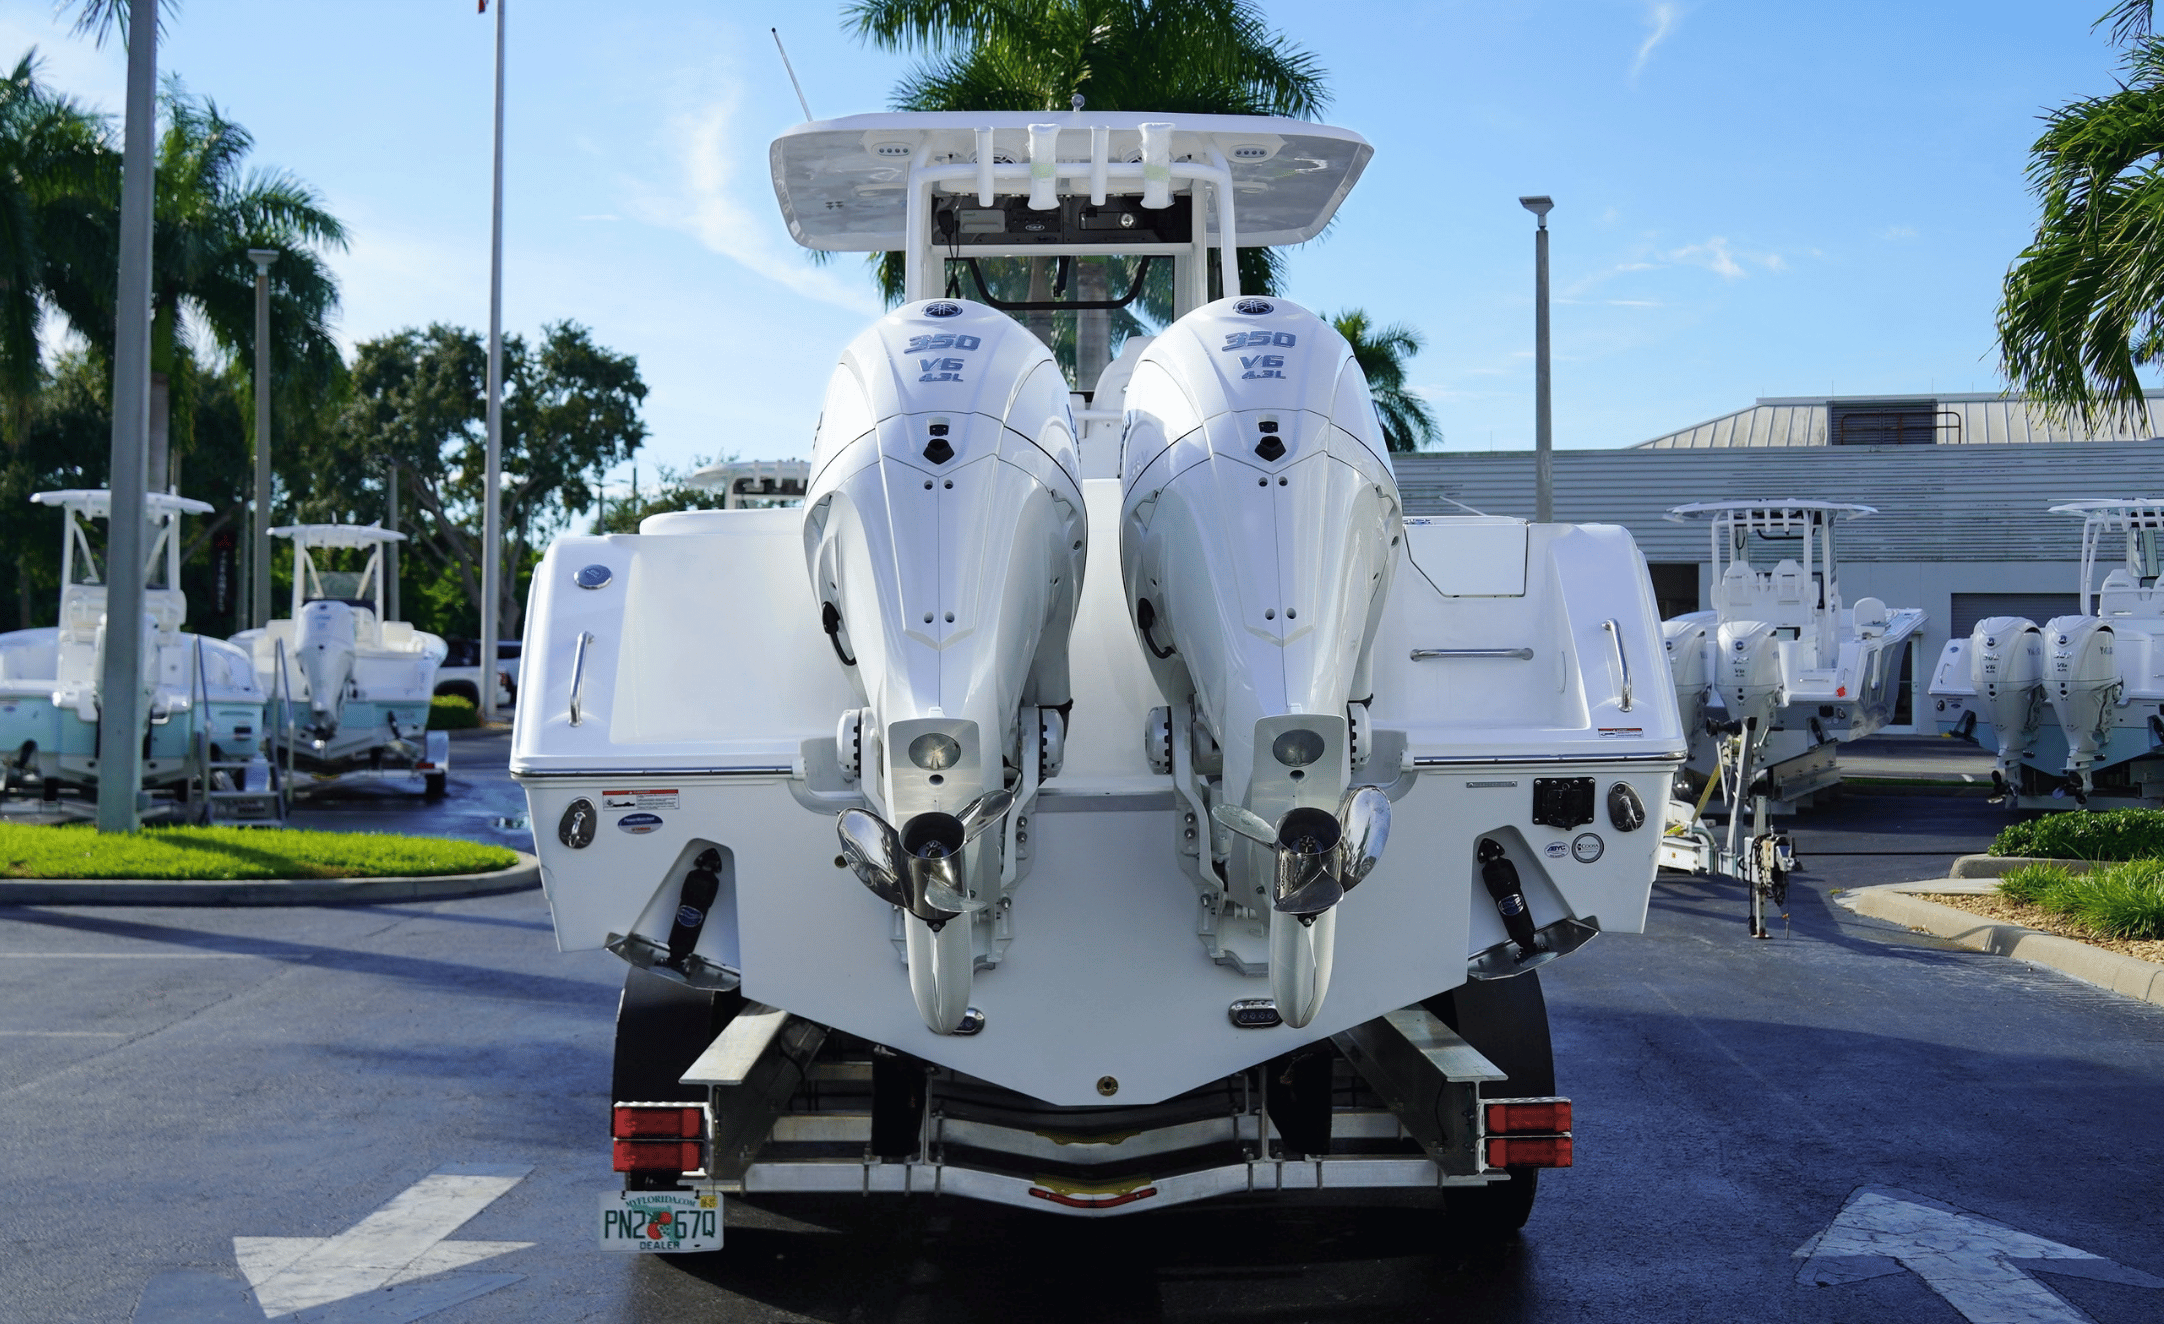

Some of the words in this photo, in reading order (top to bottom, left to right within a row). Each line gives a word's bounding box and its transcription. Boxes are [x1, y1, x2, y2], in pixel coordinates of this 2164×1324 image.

[903, 333, 981, 354] 350
[1221, 330, 1297, 351] 350
[917, 357, 965, 373] V6
[1237, 354, 1285, 370] V6
[918, 373, 964, 384] 4.3L
[1241, 370, 1287, 381] 4.3L
[605, 1210, 645, 1239] PN2
[639, 1241, 681, 1250] DEALER
